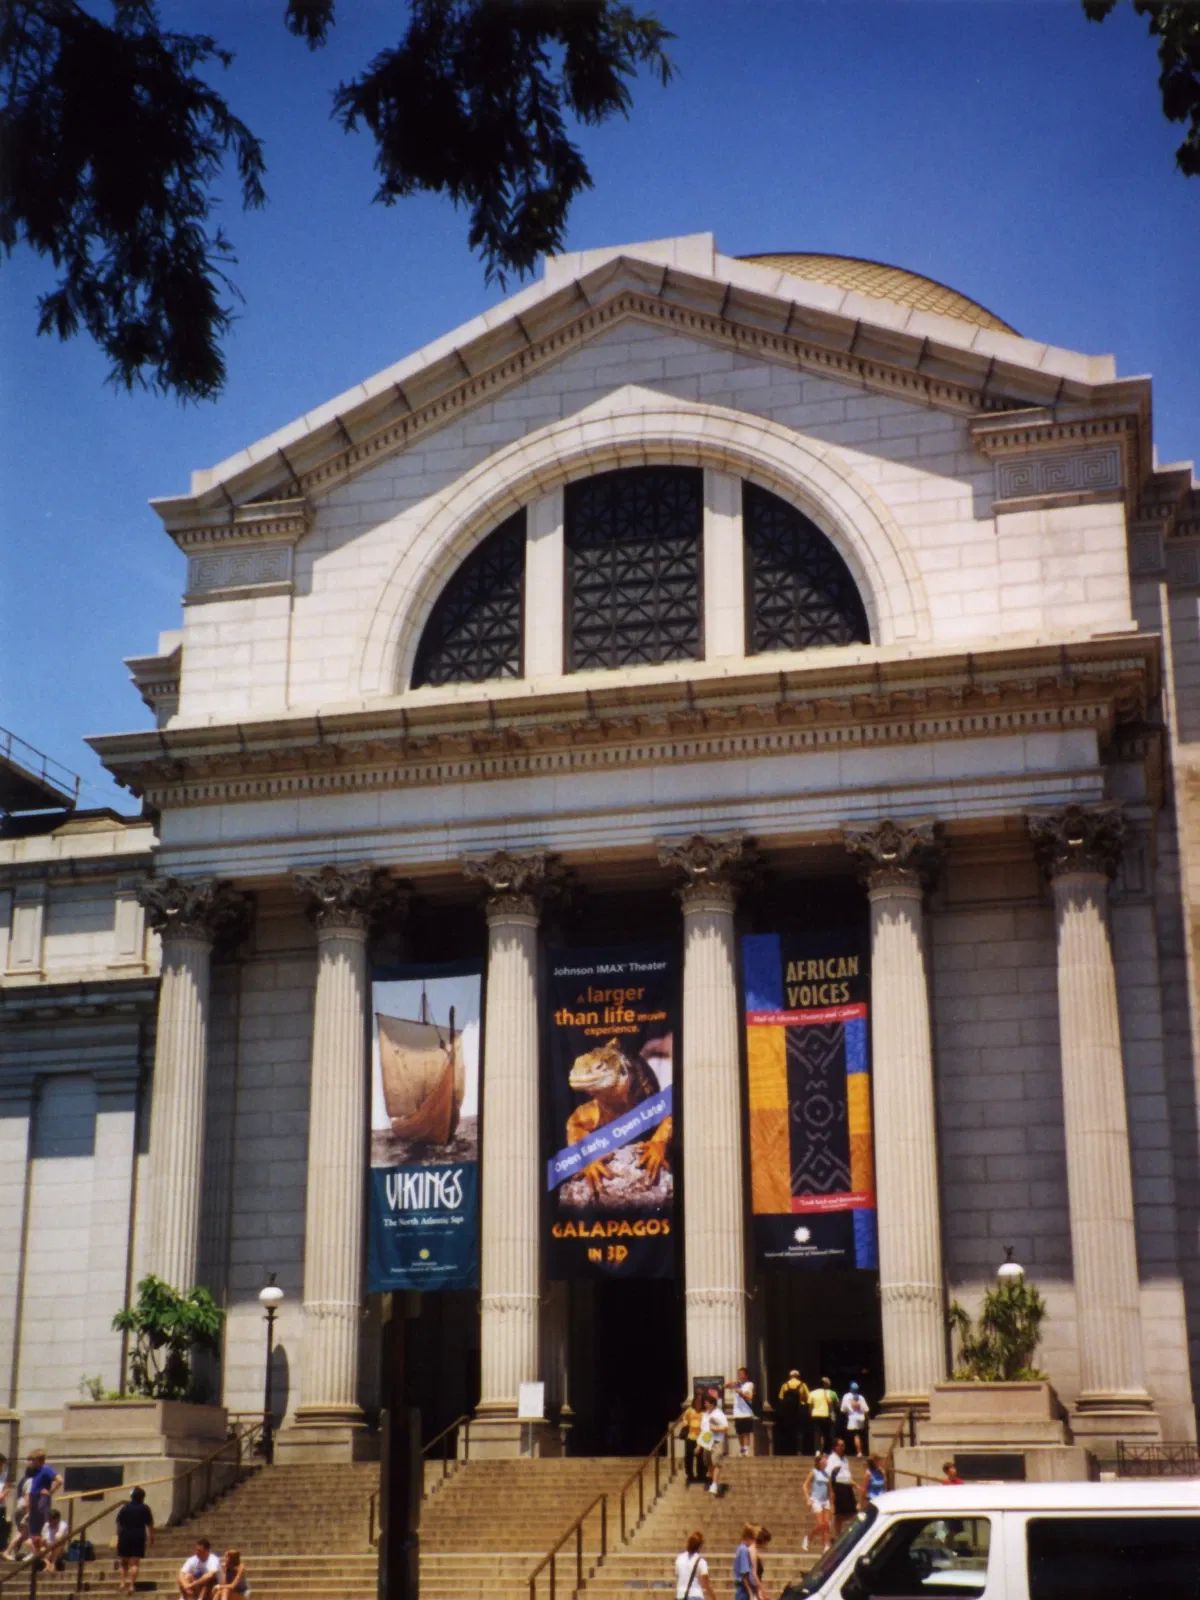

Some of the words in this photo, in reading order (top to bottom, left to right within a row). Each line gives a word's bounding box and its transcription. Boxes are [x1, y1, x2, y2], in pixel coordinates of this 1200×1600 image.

[553, 966, 594, 976] Johnson
[629, 961, 667, 971] Theater
[786, 956, 859, 981] AFRICAN
[587, 986, 645, 1006] larger
[787, 982, 850, 1007] VOICES
[554, 1008, 599, 1025] than
[604, 1007, 636, 1024] life
[555, 1154, 581, 1173] Open
[612, 1117, 641, 1138] Open
[386, 1169, 463, 1211] VIKINGS
[383, 1218, 397, 1226] The
[398, 1217, 419, 1225] North
[420, 1216, 449, 1225] Atlantic
[551, 1219, 670, 1238] GALAPAGOS
[588, 1247, 602, 1262] IN
[607, 1245, 628, 1263] 3D
